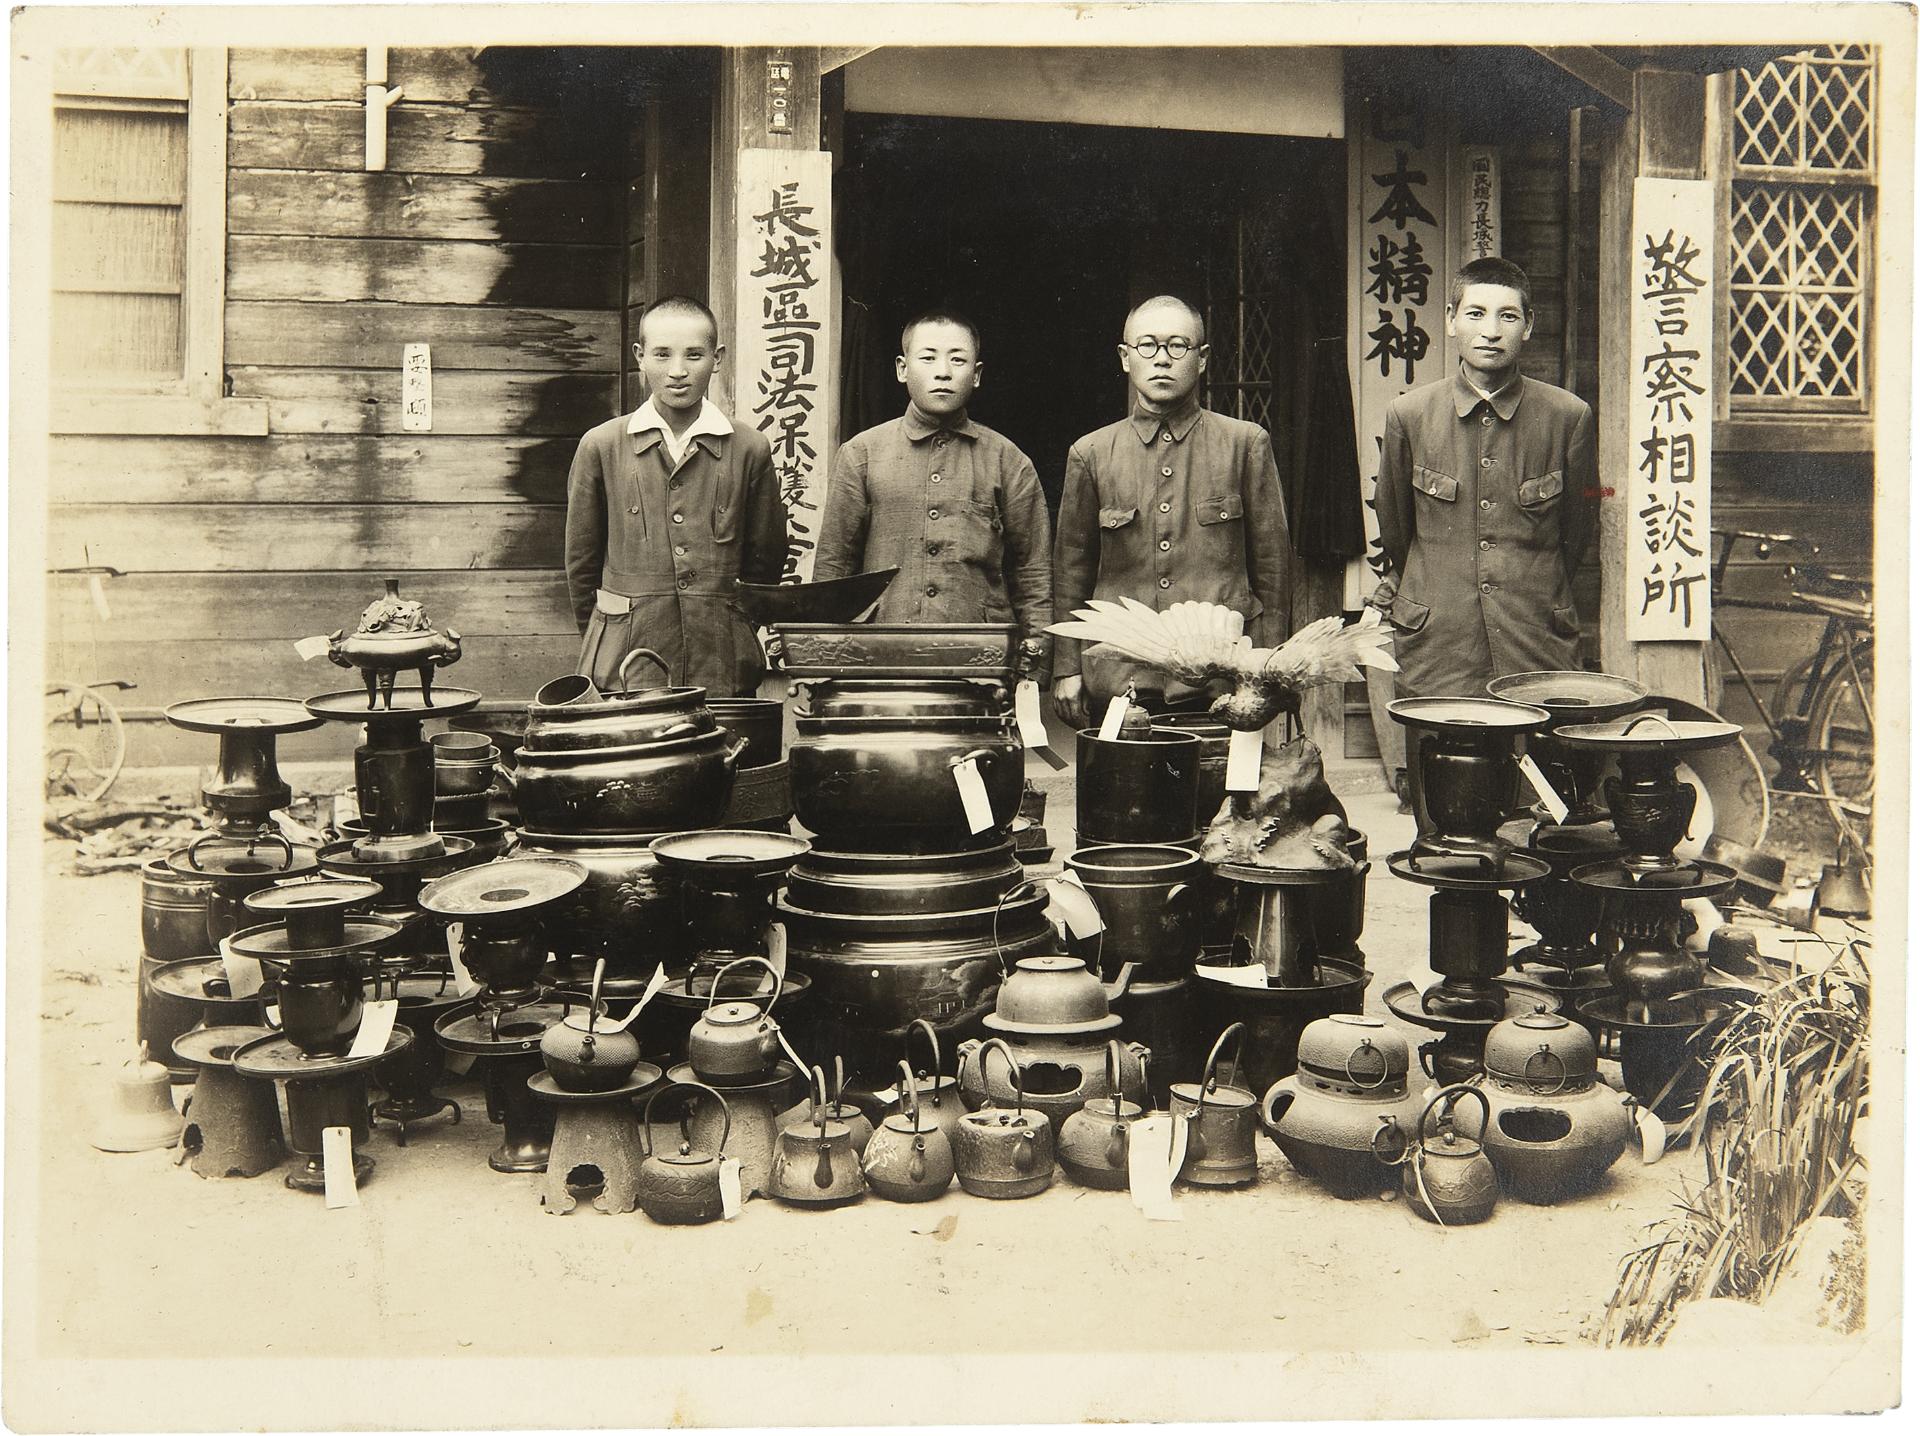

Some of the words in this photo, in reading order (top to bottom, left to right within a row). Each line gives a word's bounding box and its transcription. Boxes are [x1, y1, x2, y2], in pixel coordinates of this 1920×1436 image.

[1639, 228, 1706, 628] 警察相談所
